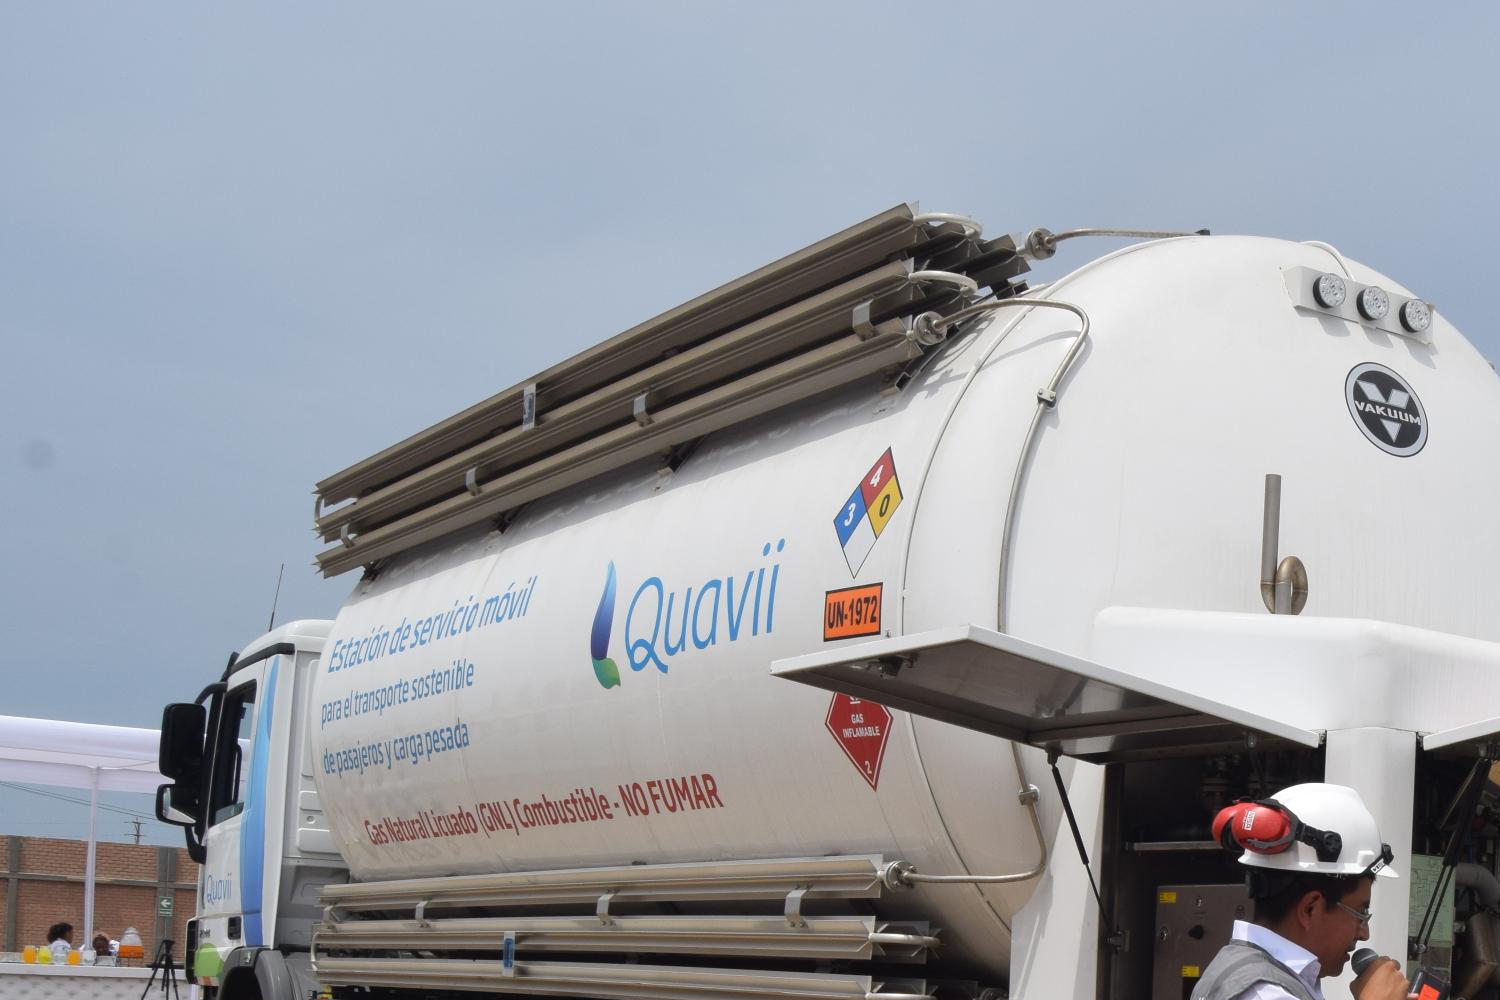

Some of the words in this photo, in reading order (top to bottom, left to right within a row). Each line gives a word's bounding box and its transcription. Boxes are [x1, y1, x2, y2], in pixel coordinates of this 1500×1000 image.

[1354, 400, 1422, 426] VAKUUM
[869, 464, 884, 488] 4
[844, 502, 857, 527] 3
[878, 493, 891, 518] 0
[625, 538, 786, 674] Quavii
[827, 595, 878, 629] UN-1972
[327, 624, 391, 674] Estación
[388, 617, 412, 656] de
[410, 595, 480, 649] servicio
[478, 575, 538, 628] móvil
[321, 700, 342, 730] para
[343, 690, 353, 718] el
[354, 679, 409, 716] transporte
[411, 658, 474, 701] sostenible
[842, 726, 881, 738] INFLAMABLE
[850, 713, 865, 724] GAS
[323, 747, 336, 774] de
[336, 740, 384, 779] pasajeros
[385, 740, 392, 770] y
[393, 733, 424, 764] carga
[425, 716, 470, 762] pesada
[865, 760, 873, 774] 2
[364, 819, 389, 846] Gas
[383, 811, 431, 842] Natural
[424, 805, 479, 838] Licuado
[475, 801, 520, 838] (GNL)
[513, 787, 613, 828] Combustible
[618, 782, 650, 817] NO
[646, 773, 725, 814] FUMAR
[207, 873, 232, 905] Quavii
